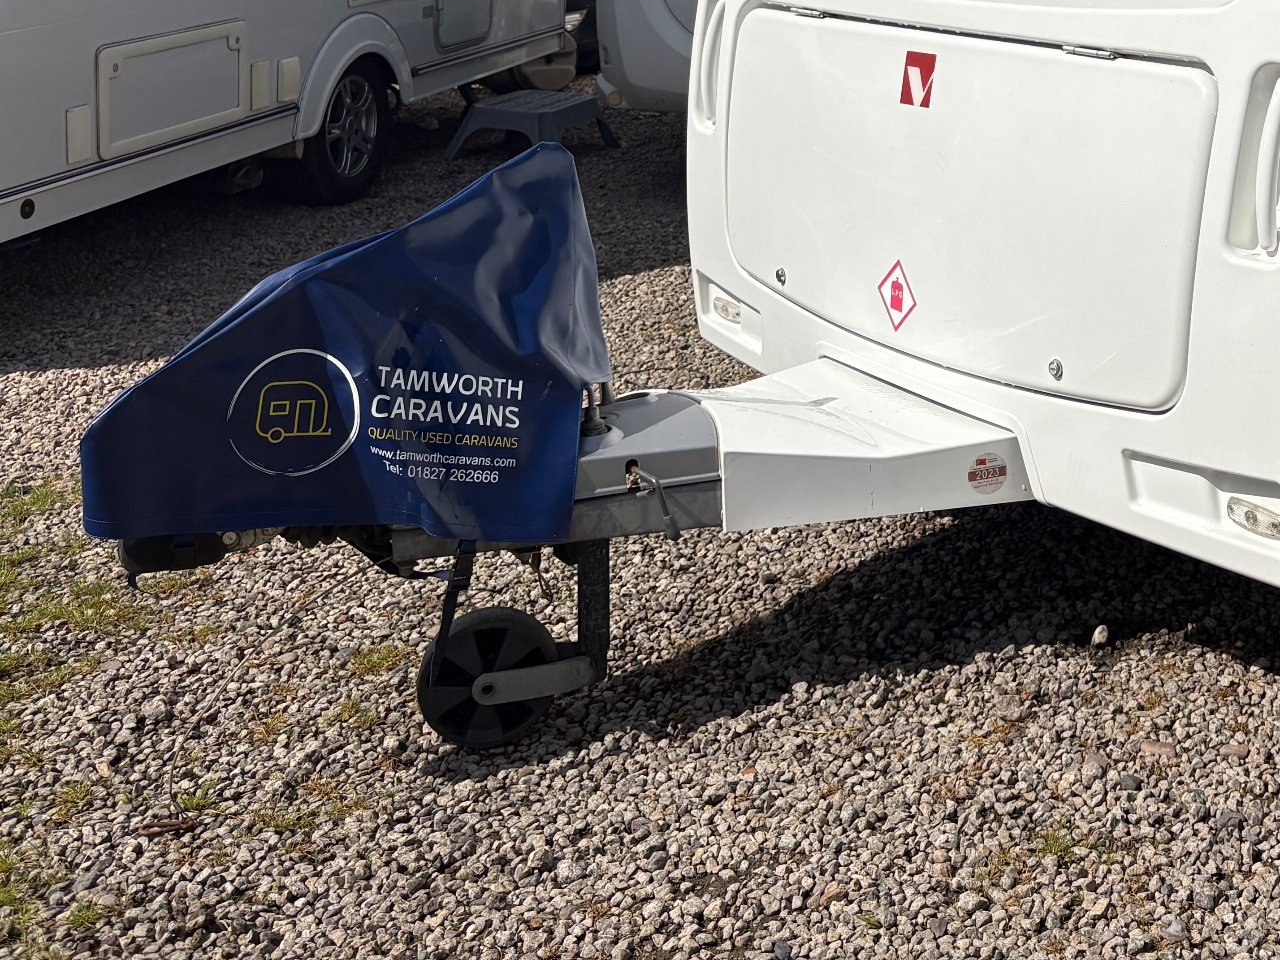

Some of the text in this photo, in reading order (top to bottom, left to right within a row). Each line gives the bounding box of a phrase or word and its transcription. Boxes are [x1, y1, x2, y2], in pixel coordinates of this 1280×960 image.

[378, 366, 523, 400] TAMWORTH
[371, 394, 520, 428] CARAVANS
[368, 427, 518, 448] QUALITY USED CARAVANS
[370, 445, 516, 467] www.tamworthcaravans.com
[383, 460, 499, 483] Tel: 01827 262666
[976, 467, 1000, 480] 2023
